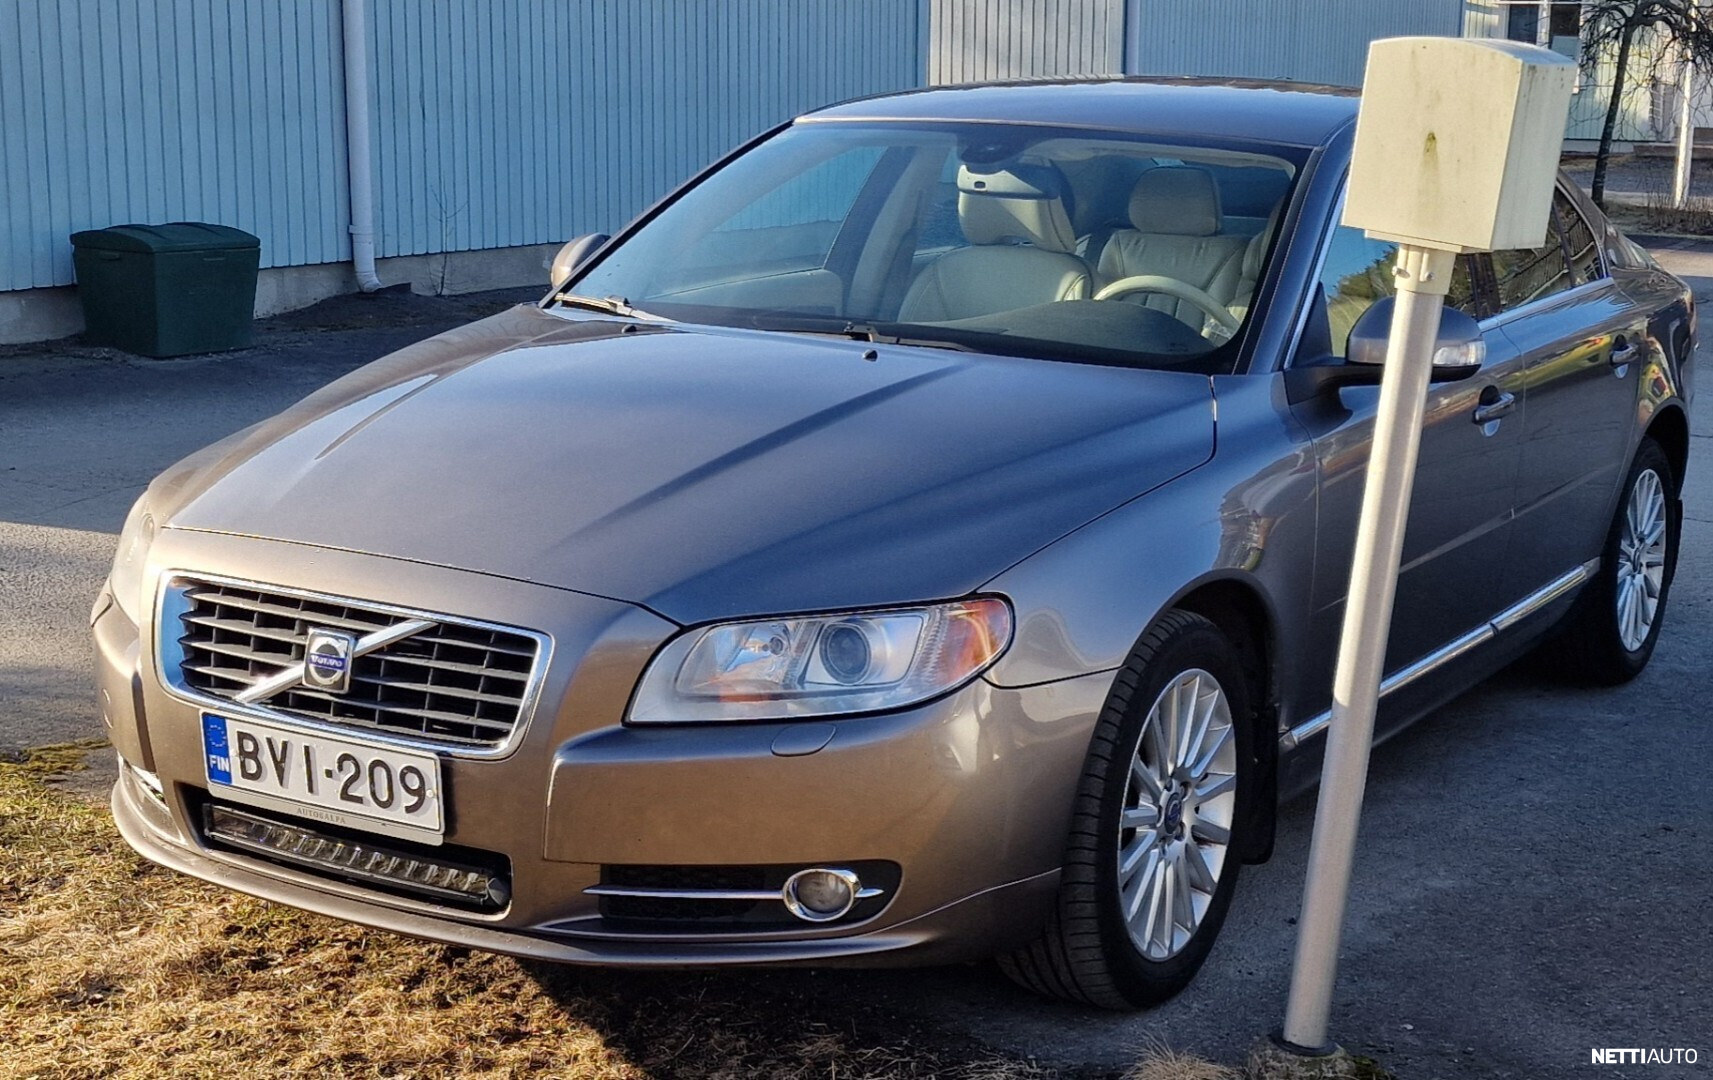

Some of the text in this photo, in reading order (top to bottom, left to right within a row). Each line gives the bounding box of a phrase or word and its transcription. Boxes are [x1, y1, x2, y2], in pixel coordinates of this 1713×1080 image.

[310, 654, 343, 668] VOLVO
[209, 754, 230, 772] FIN
[236, 730, 426, 814] BVI-209
